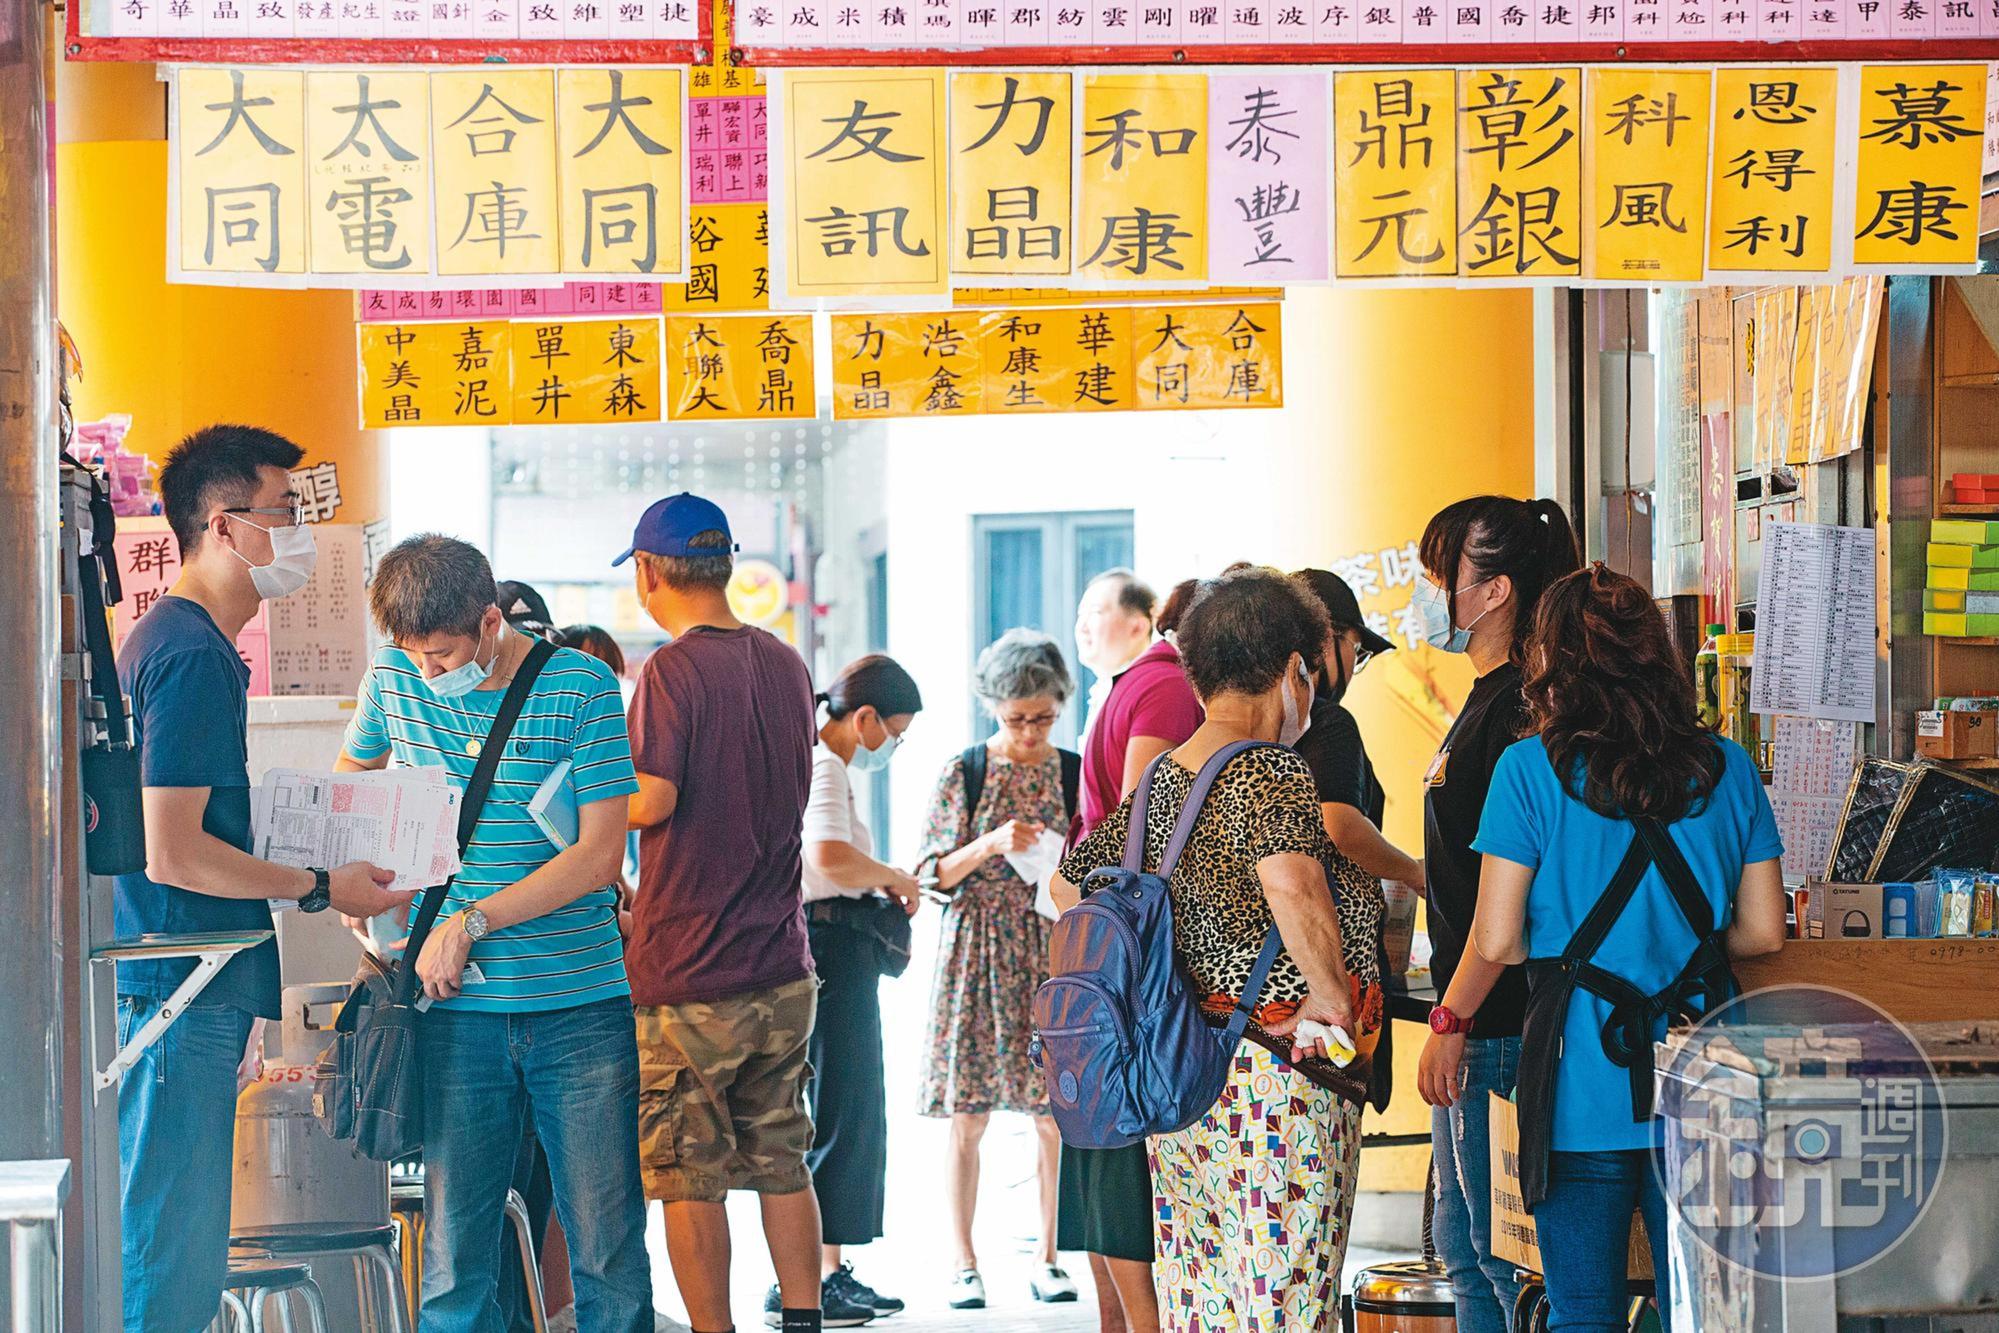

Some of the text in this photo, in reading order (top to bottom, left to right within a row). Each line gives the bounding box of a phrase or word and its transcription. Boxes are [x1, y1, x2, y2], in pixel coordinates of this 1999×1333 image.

[213, 1, 238, 19] 晶
[256, 1, 286, 18] 致
[528, 4, 558, 21] 致
[573, 3, 601, 22] 維
[619, 3, 644, 22] 塑
[660, 3, 690, 22] 捷
[749, 6, 774, 27] 豪
[790, 7, 819, 27] 成
[837, 8, 860, 27] 米
[879, 6, 907, 26] 積
[1011, 8, 1040, 27] 郡
[1057, 8, 1085, 26] 紡
[1103, 7, 1128, 27] 雲
[1145, 8, 1172, 27] 剛
[1190, 7, 1218, 26] 曜
[1233, 7, 1262, 26] 通
[1278, 6, 1306, 25] 波
[1321, 6, 1349, 26] 序
[1364, 7, 1395, 24] 銀
[1412, 6, 1438, 26] 普
[1457, 7, 1480, 25] 國
[1499, 5, 1529, 26] 喬
[1541, 5, 1572, 25] 捷
[1587, 5, 1615, 25] 邦
[1858, 1, 1879, 21] 甲
[1898, 0, 1928, 20] 泰
[1942, 1, 1974, 18] 訊
[695, 103, 712, 142] 單井
[196, 70, 295, 273] 大同
[323, 76, 419, 269] 太電
[447, 84, 544, 258] 合庫
[573, 69, 676, 274] 大同
[696, 154, 714, 192] 瑞利
[725, 153, 744, 191] 聯上
[804, 100, 930, 257] 友訊
[962, 77, 1061, 260] 力晶
[1225, 86, 1300, 266] 泰豐
[1351, 79, 1445, 263] 鼎元
[1459, 70, 1580, 276] 彰銀
[1600, 92, 1691, 233] 科風
[1722, 82, 1817, 257] 恩得利
[1856, 80, 1986, 246] 慕康
[1079, 109, 1197, 275] 和康
[383, 328, 420, 421] 中美晶
[453, 326, 496, 416] 嘉泥
[531, 326, 571, 419] 單井
[603, 324, 646, 416] 東森
[684, 323, 727, 412] 大聯大
[757, 321, 797, 411] 喬鼎
[852, 321, 889, 408] 力晶
[923, 319, 964, 410] 浩鑫
[1000, 316, 1042, 406] 和康生
[1075, 312, 1118, 405] 華建
[1152, 314, 1193, 403] 大同
[1223, 309, 1266, 402] 合庫
